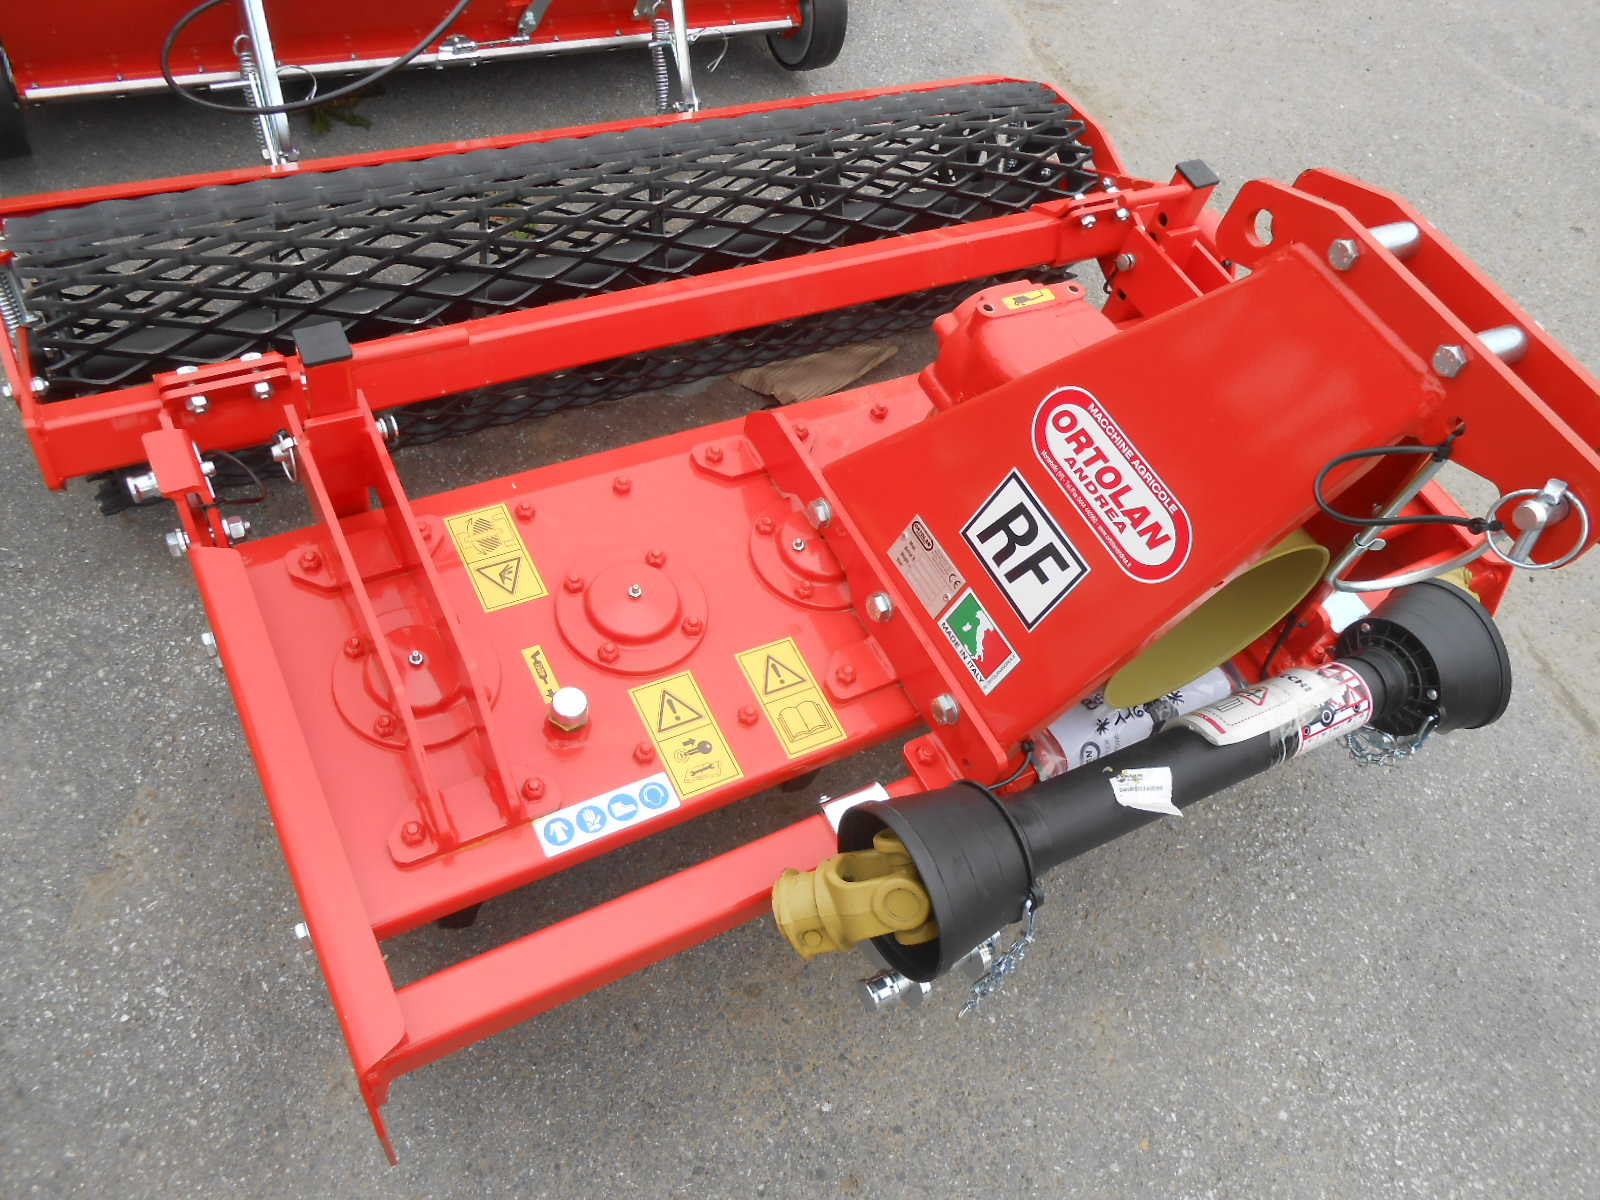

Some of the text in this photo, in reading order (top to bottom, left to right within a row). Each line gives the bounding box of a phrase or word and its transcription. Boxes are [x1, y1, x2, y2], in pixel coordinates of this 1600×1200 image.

[1052, 410, 1171, 550] ORTOLAN
[1064, 457, 1128, 534] ANDREA
[1087, 403, 1178, 515] MACCHINE AGRICOLE
[976, 501, 1070, 585] RF
[941, 622, 985, 683] MADE IN ITALY
